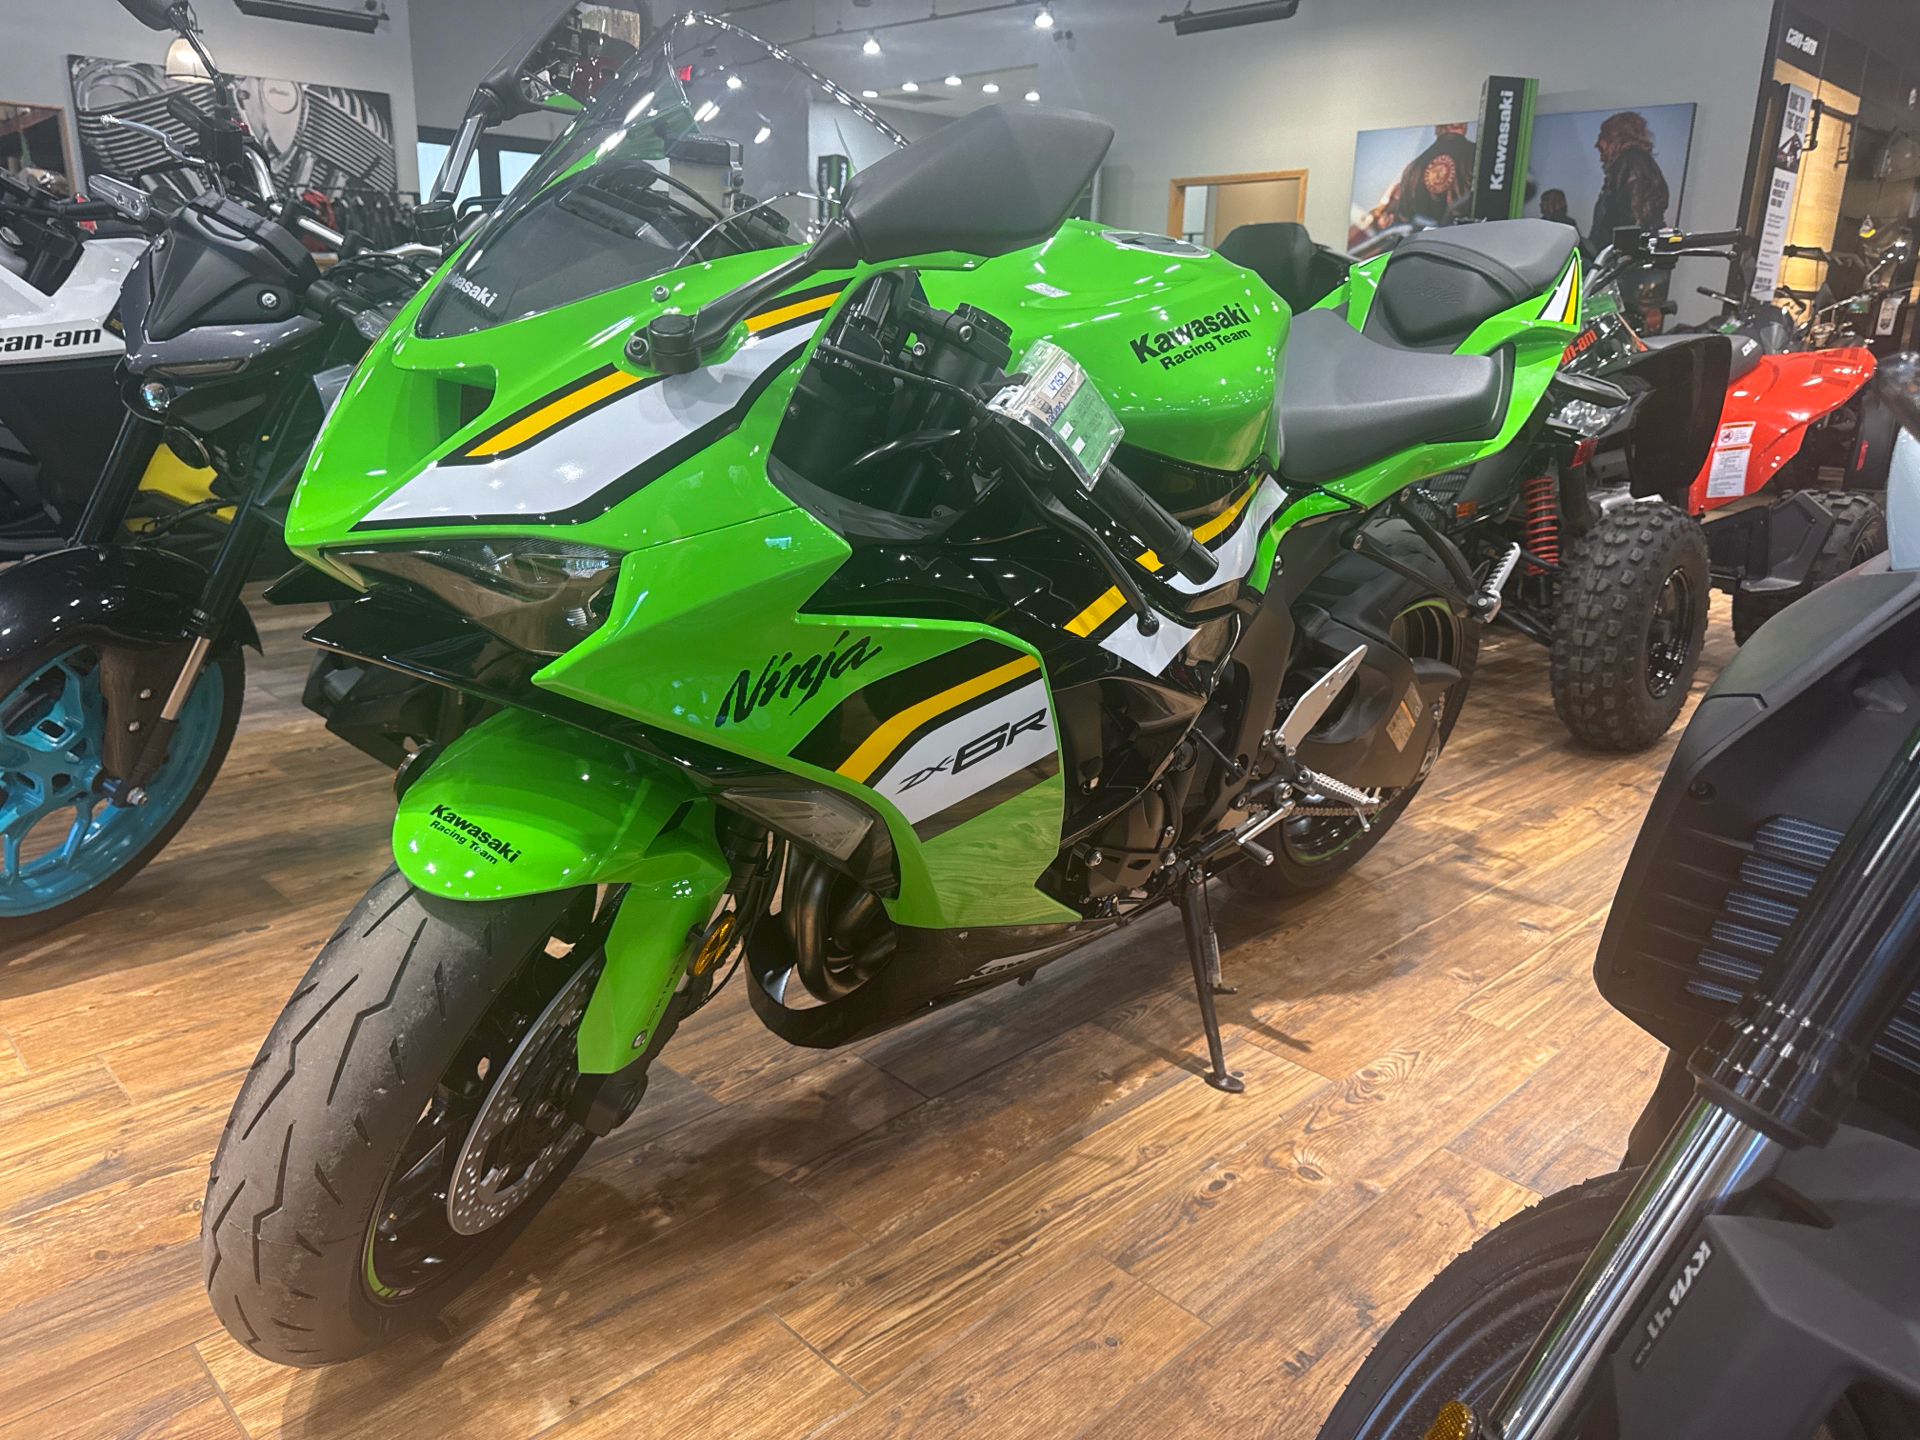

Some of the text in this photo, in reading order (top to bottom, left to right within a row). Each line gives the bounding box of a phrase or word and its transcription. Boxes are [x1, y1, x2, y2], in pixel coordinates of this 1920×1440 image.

[1489, 90, 1514, 190] Kawasaki
[0, 328, 101, 353] an-am
[1129, 302, 1252, 365] Kawasaki
[1160, 329, 1252, 371] Racing Team
[1562, 329, 1598, 365] n-am
[1048, 370, 1068, 391] 4759
[714, 630, 883, 728] Ninja
[895, 707, 1048, 795] ZX-6R
[429, 820, 468, 845] Racing
[429, 804, 522, 863] Kawasaki
[1669, 1240, 1711, 1306] KYB
[1646, 1306, 1672, 1339] 41
